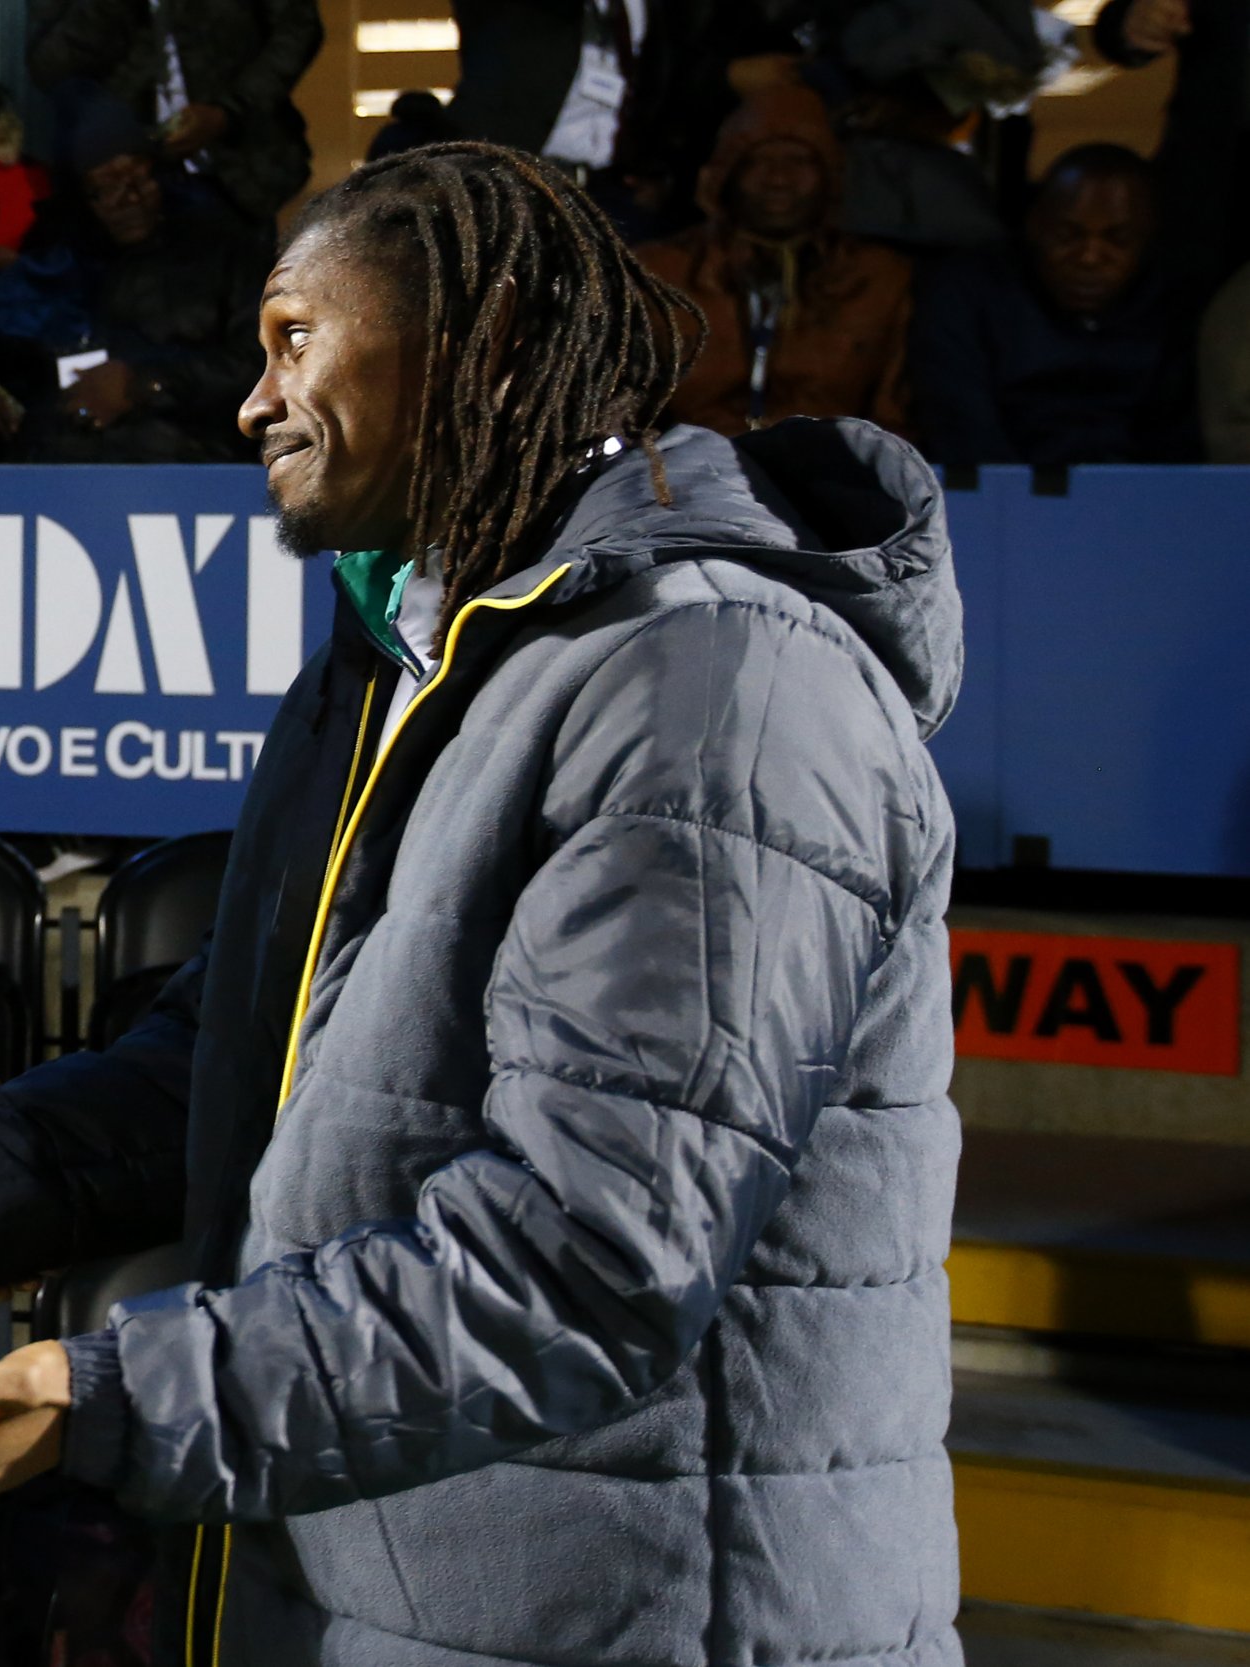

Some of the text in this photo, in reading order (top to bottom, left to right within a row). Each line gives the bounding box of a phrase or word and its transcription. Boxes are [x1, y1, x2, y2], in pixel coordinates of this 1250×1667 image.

[59, 727, 99, 777] E
[104, 720, 267, 782] CULT
[950, 953, 1204, 1044] WAY
